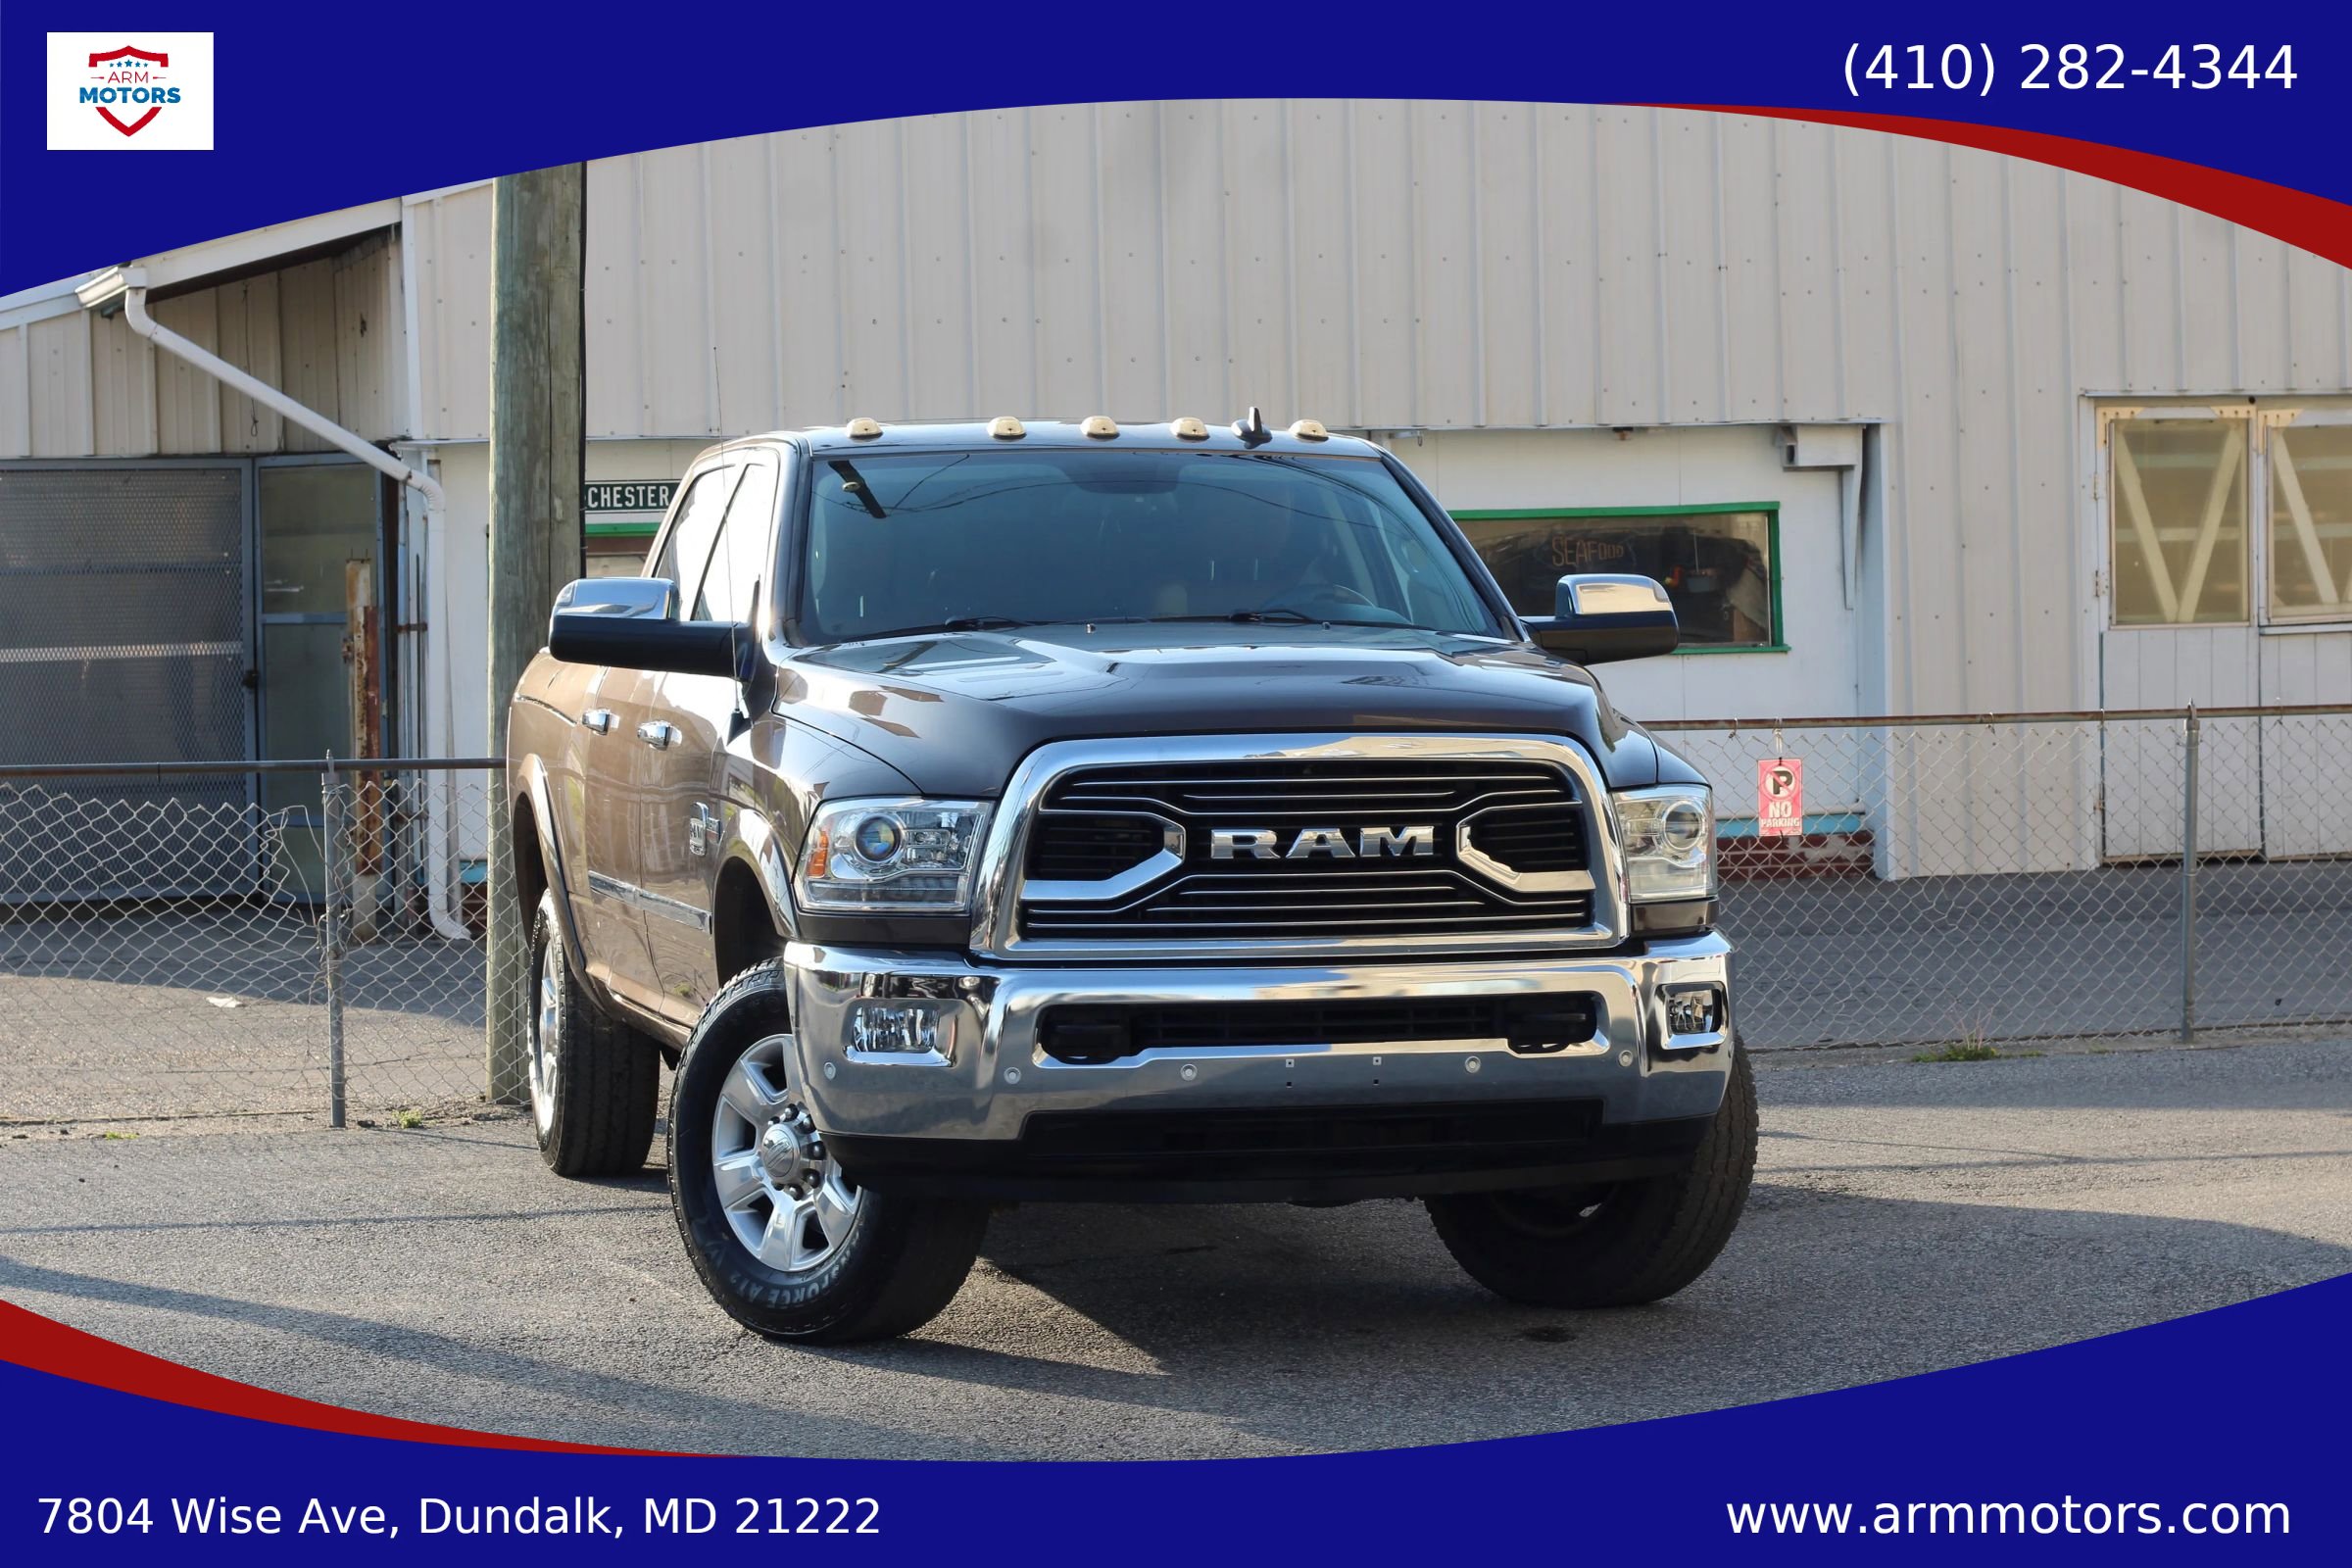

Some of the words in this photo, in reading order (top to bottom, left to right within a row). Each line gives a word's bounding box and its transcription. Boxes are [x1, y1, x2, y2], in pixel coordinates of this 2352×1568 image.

[585, 486, 669, 508] CHESTER
[1769, 802, 1792, 818] NO
[1760, 817, 1800, 828] PARKING
[1211, 826, 1435, 859] RAM
